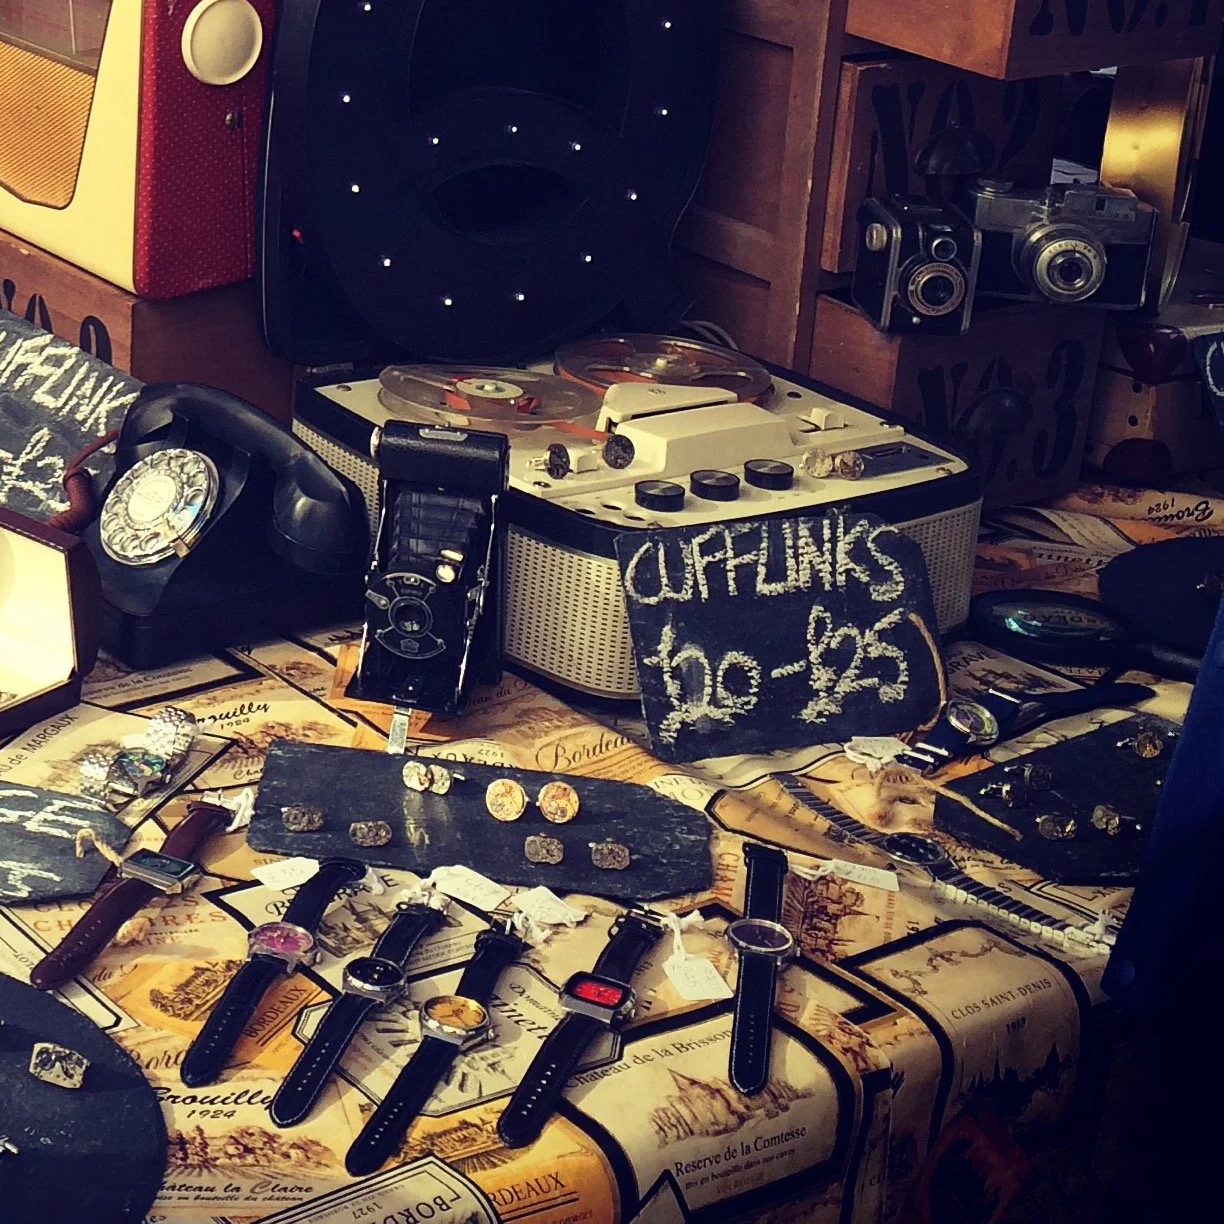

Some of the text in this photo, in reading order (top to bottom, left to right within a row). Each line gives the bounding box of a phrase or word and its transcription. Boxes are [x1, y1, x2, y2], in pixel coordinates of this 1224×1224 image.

[624, 515, 905, 605] CUFFLINKS
[21, 712, 78, 755] MARGAUX
[243, 984, 308, 1039] BORDEAUX
[951, 1000, 982, 1020] CLOS
[633, 1052, 654, 1066] de
[657, 1044, 673, 1058] la
[186, 1108, 238, 1120] 1924
[674, 1126, 807, 1177] Reserve de la Comtesse
[223, 1182, 243, 1194] la
[250, 1179, 314, 1194] Claire
[351, 1200, 382, 1219] 1927
